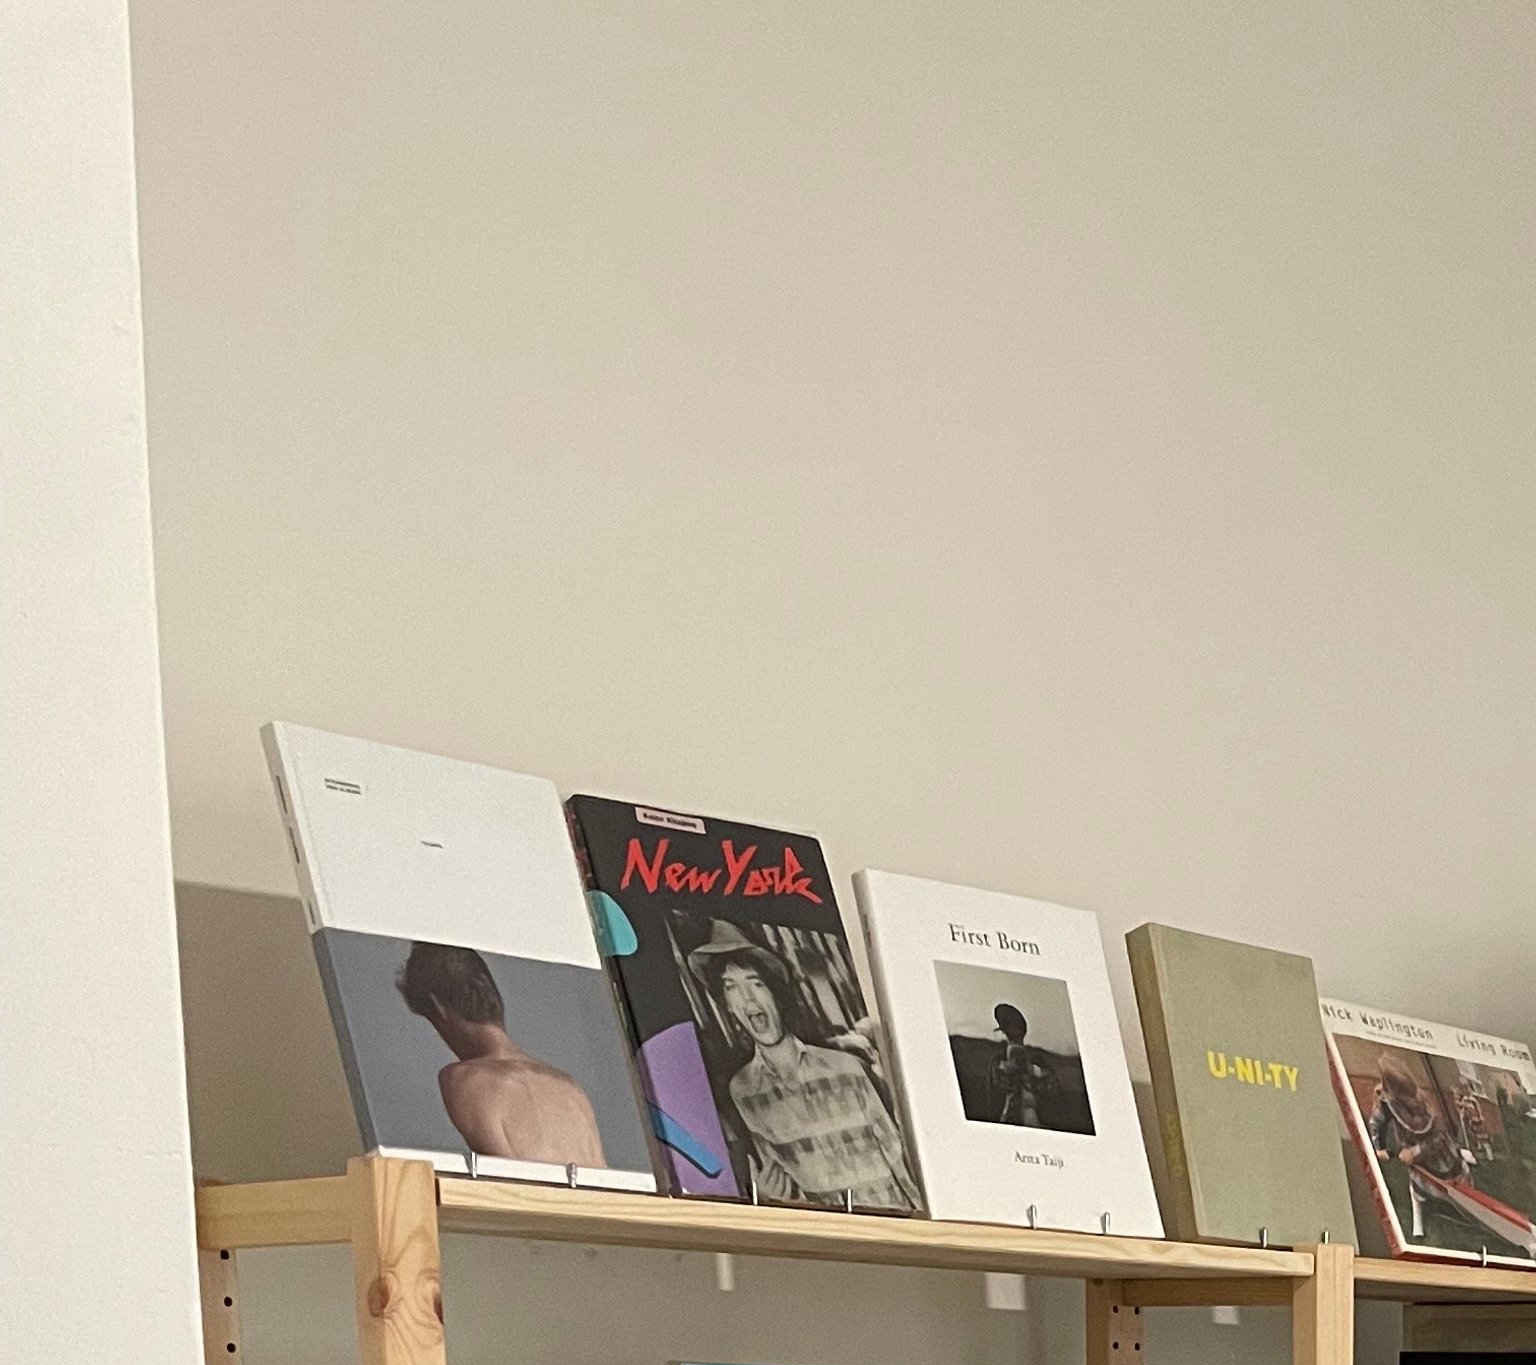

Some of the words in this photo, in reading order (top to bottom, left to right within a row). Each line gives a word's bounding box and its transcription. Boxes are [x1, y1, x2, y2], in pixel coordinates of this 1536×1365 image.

[620, 838, 722, 895] New
[721, 839, 823, 904] York
[948, 923, 991, 948] First
[997, 931, 1041, 955] Born
[1321, 1003, 1353, 1022] Nick
[1359, 1012, 1434, 1040] Waplington
[1456, 1033, 1497, 1055] Living
